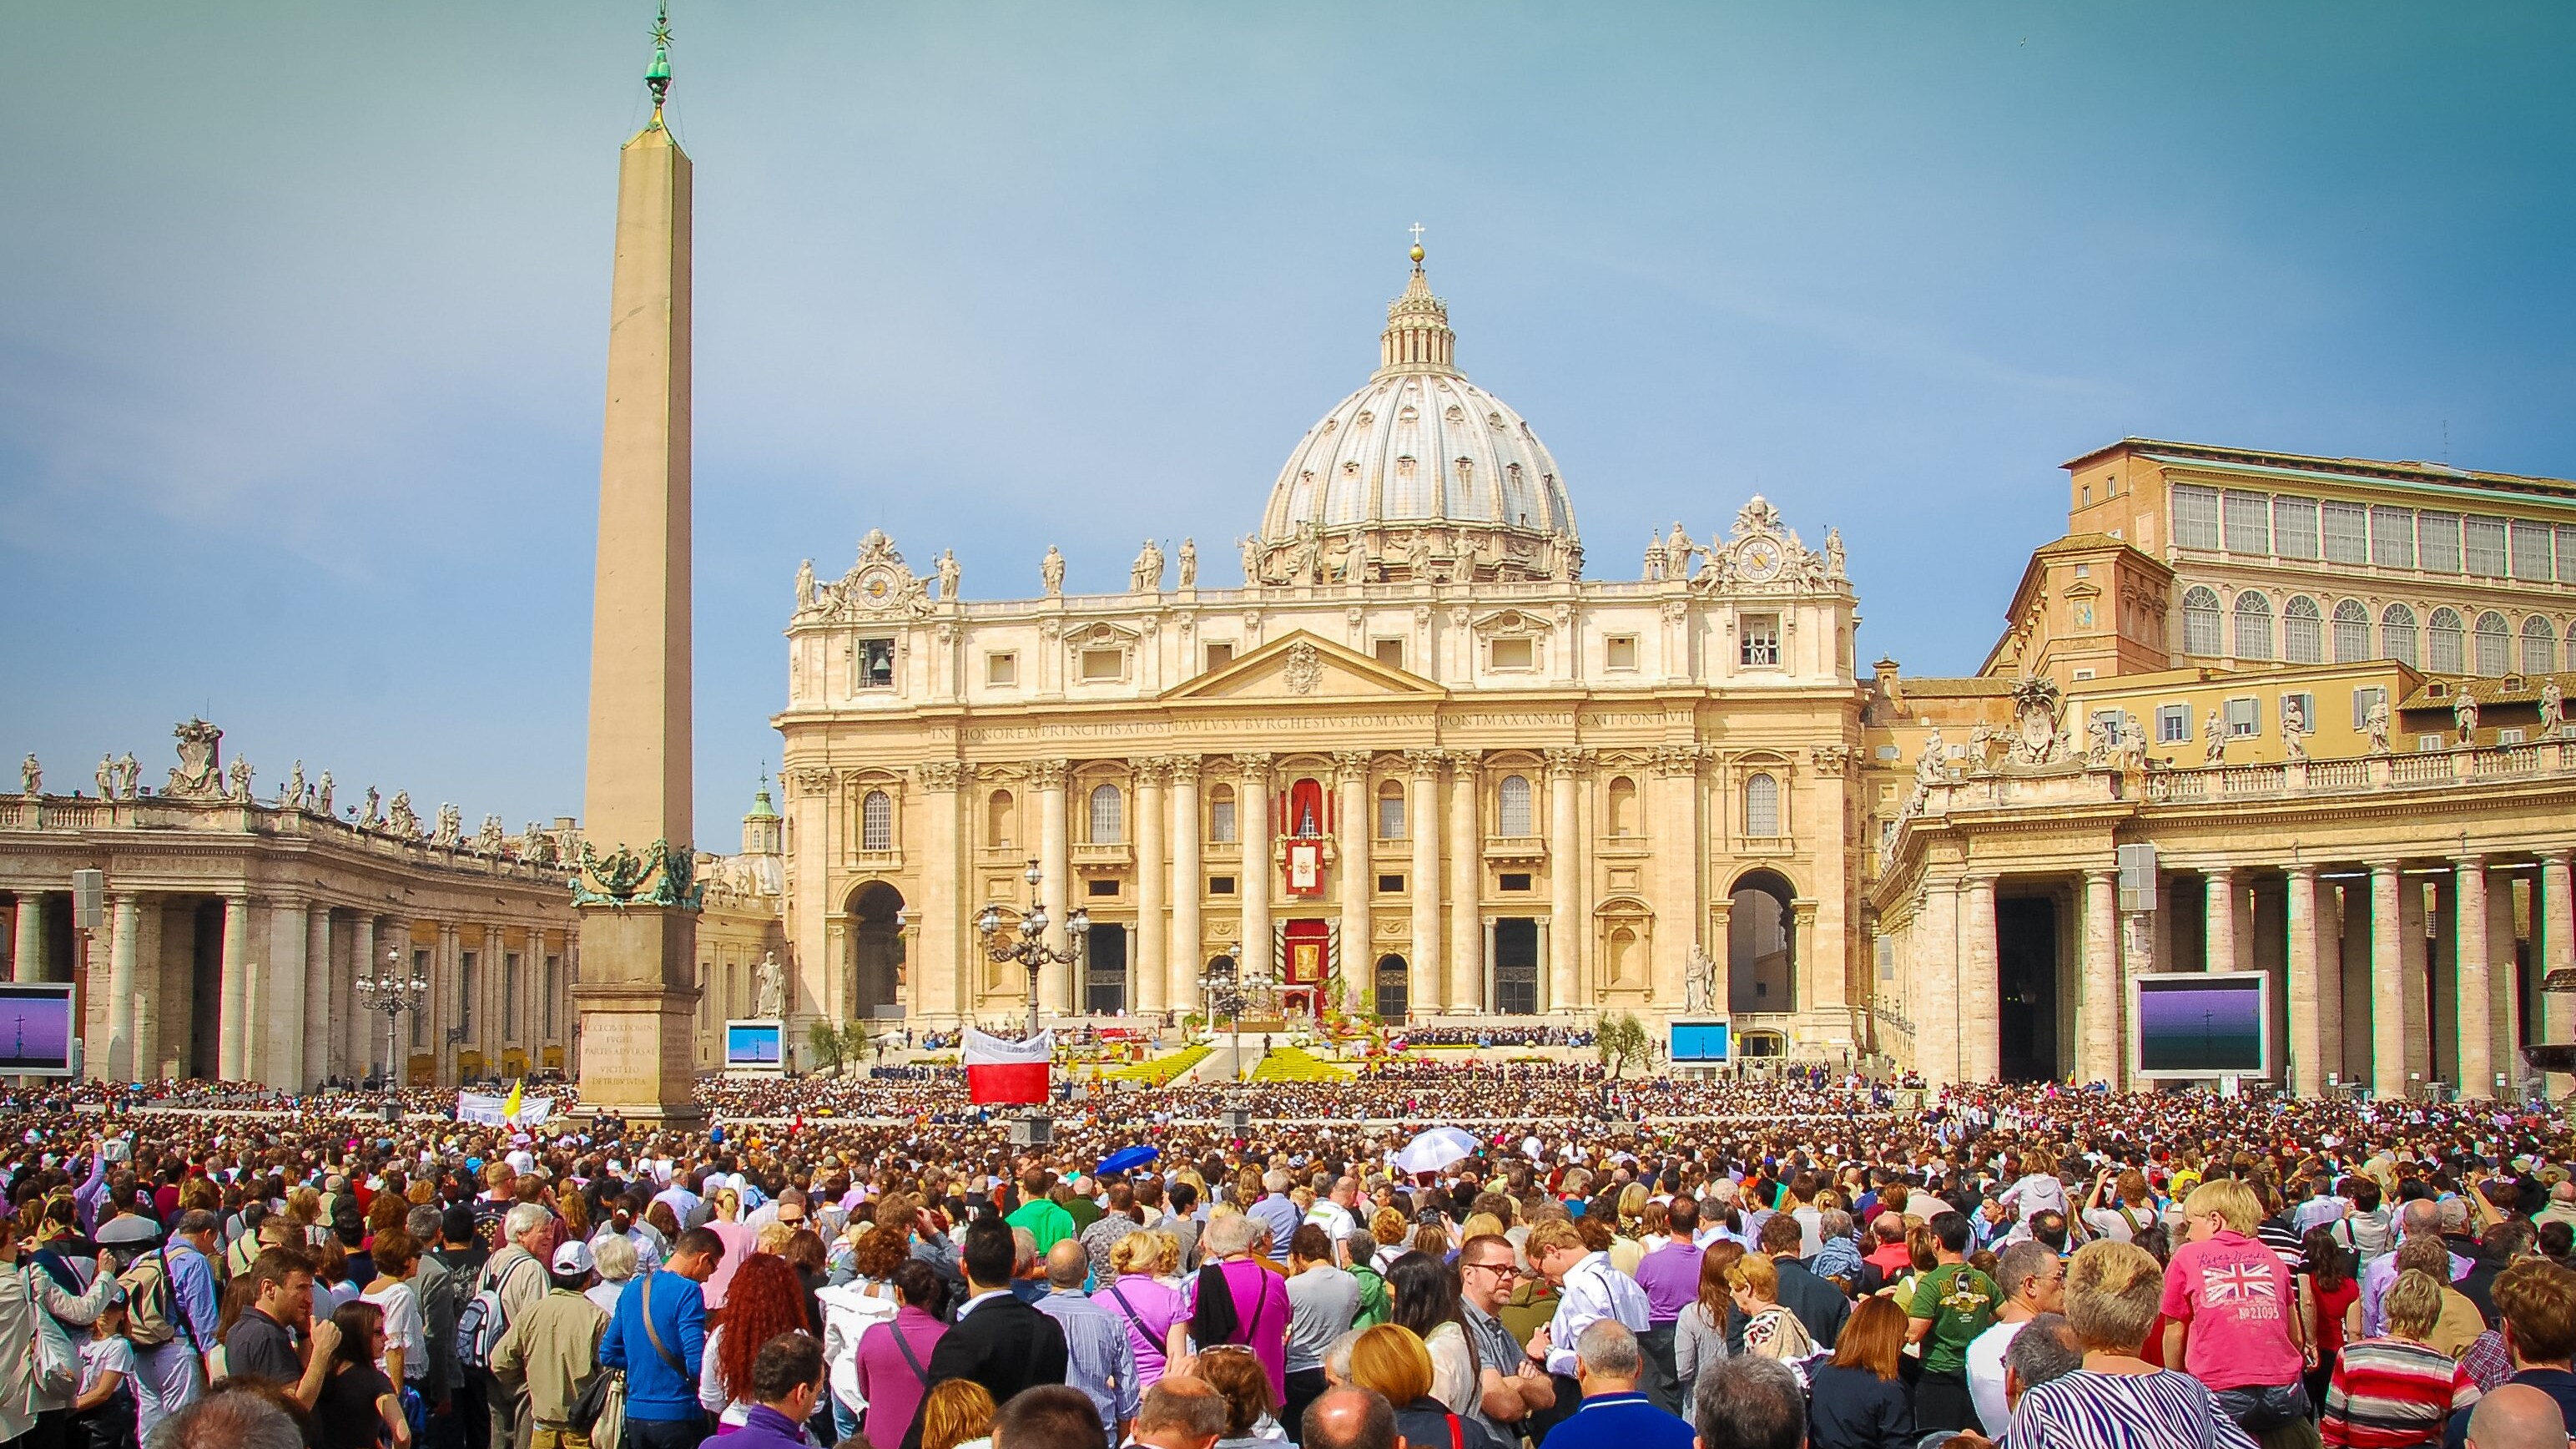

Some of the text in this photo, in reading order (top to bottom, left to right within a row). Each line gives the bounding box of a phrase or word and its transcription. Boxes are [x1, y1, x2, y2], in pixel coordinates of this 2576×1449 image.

[931, 728, 950, 740] IN
[960, 727, 1039, 740] HONOREM
[1041, 723, 1122, 737] PRINCIPIS
[1245, 716, 1347, 730] BVRGHESIVS
[1350, 714, 1435, 728] ROMANVS
